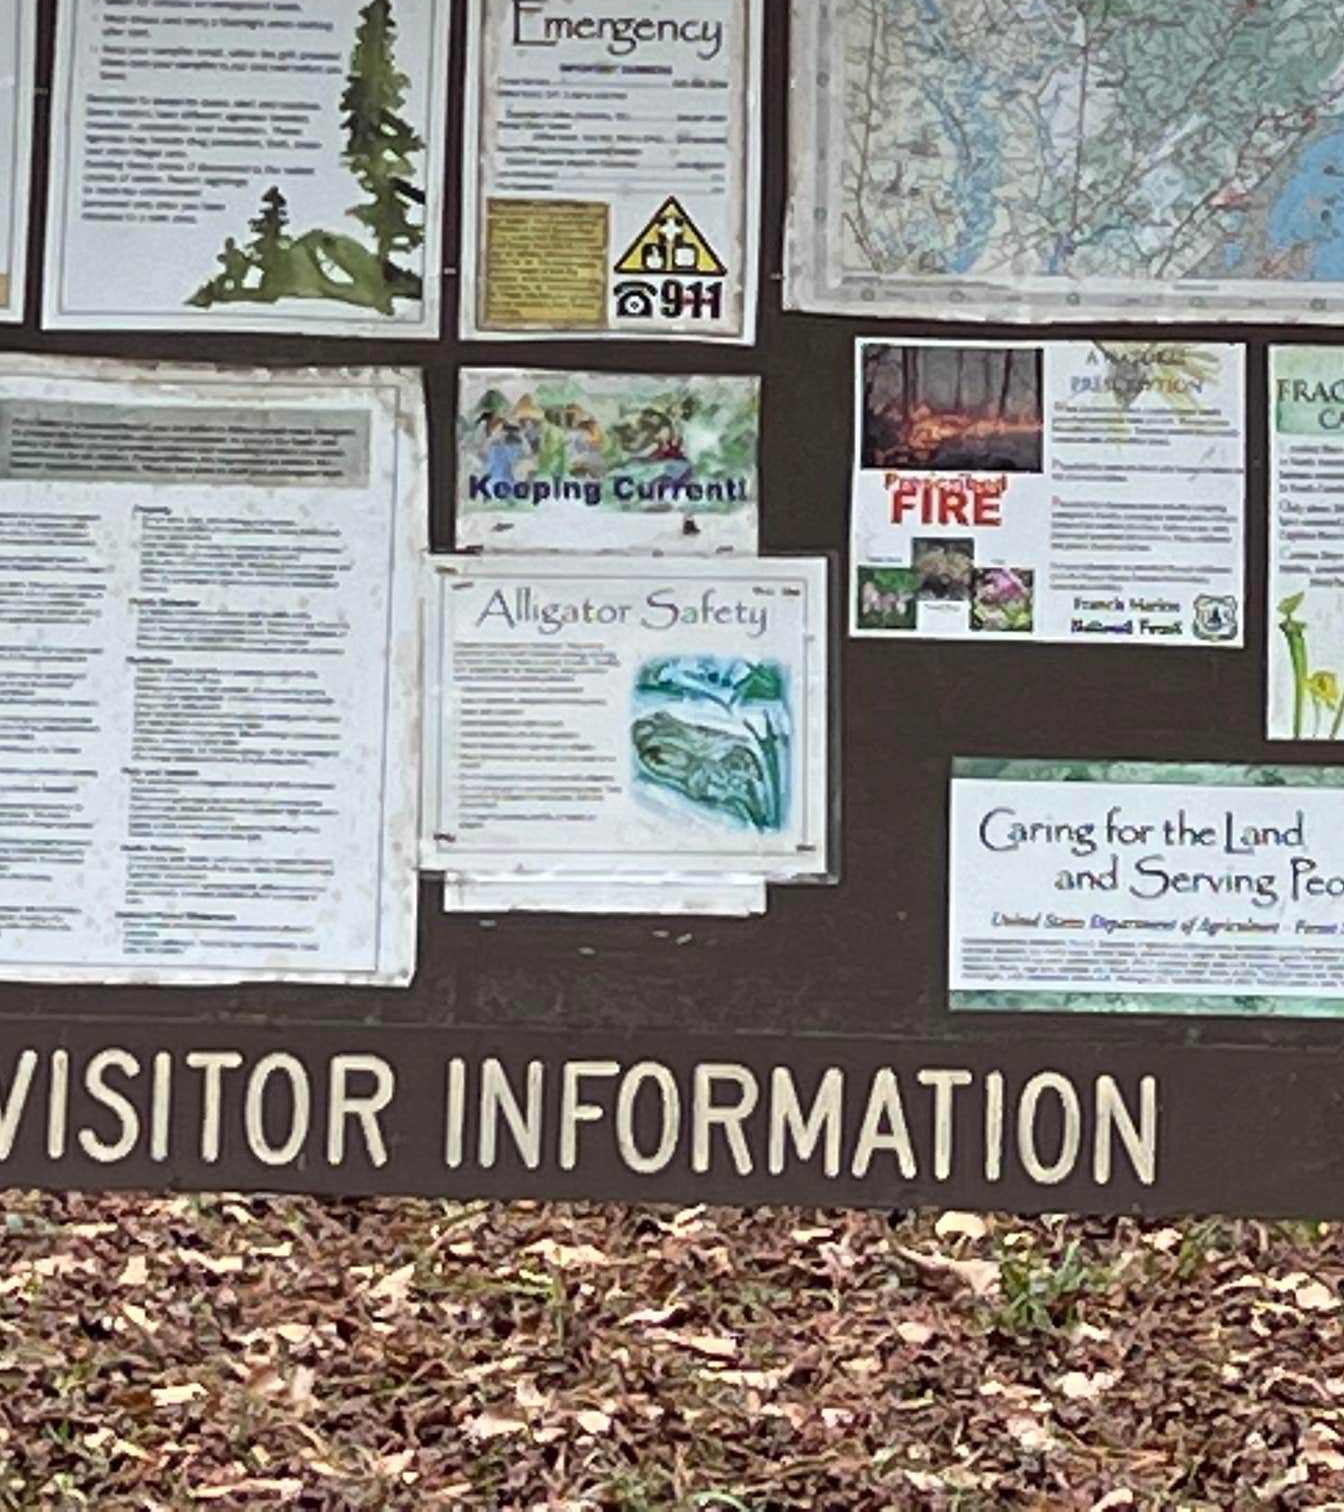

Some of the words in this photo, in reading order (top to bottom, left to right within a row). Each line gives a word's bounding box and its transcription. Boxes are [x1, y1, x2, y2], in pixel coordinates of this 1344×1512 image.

[468, 474, 602, 505] Keeping
[613, 476, 747, 502] Current!
[890, 489, 1002, 526] FIRE
[475, 586, 632, 636] Alligator
[641, 588, 769, 637] Safety
[979, 807, 1097, 857] Caring
[1106, 805, 1154, 846] for
[1163, 809, 1216, 846] the
[1224, 810, 1304, 854] Land
[1054, 853, 1119, 891] and
[1129, 854, 1278, 908] Serving
[445, 1057, 1157, 1185] INFORMATION
